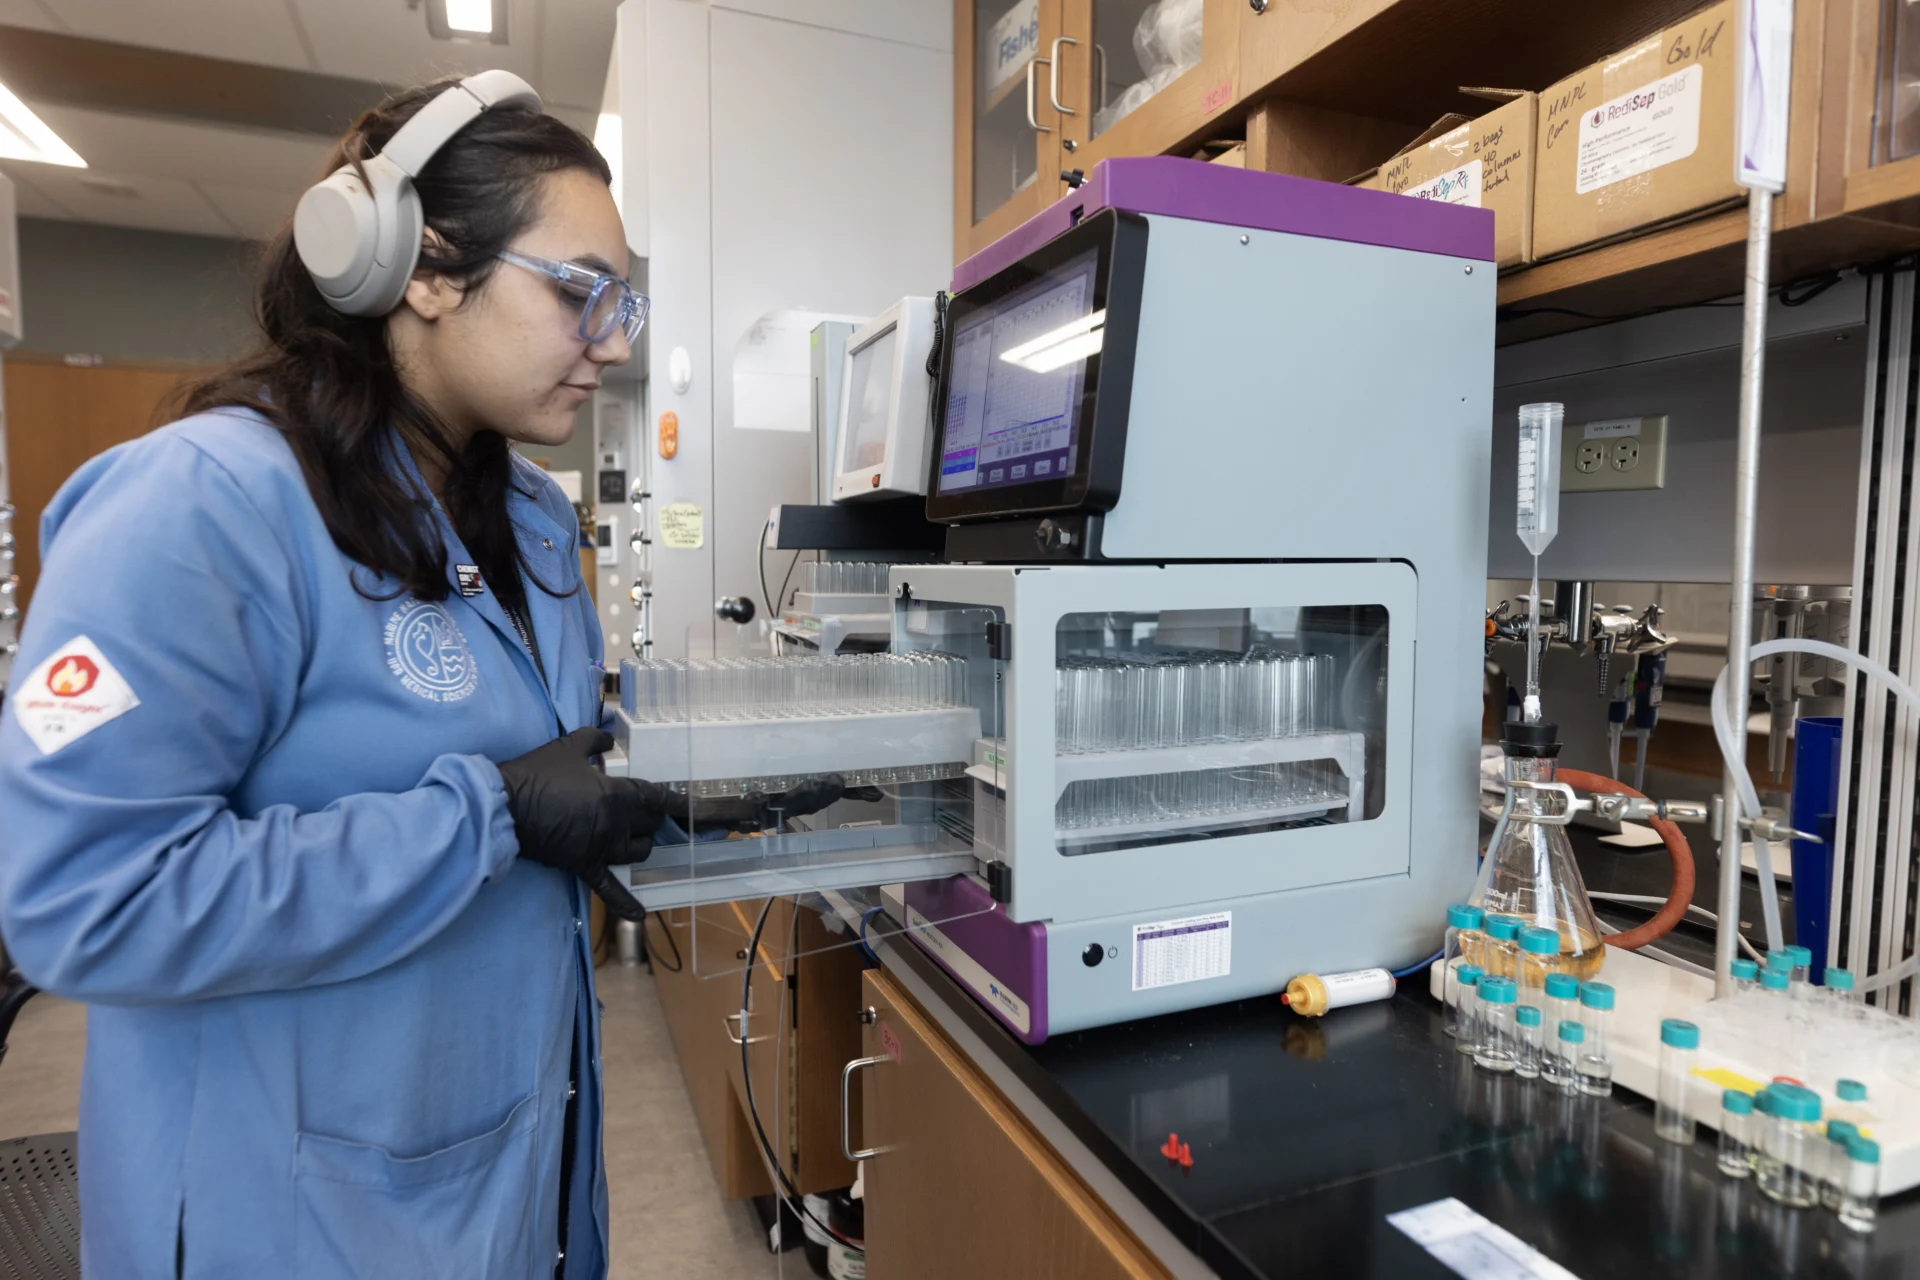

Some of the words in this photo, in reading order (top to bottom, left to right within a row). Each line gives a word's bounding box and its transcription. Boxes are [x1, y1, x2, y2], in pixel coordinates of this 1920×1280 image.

[1666, 19, 1725, 65] Gold
[1608, 91, 1656, 122] RediSep
[1652, 106, 1674, 121] GOLD
[1474, 142, 1481, 154] 2
[1482, 125, 1503, 148] bags
[1482, 149, 1521, 179] columns
[1484, 150, 1497, 163] 40
[1483, 168, 1510, 193] total
